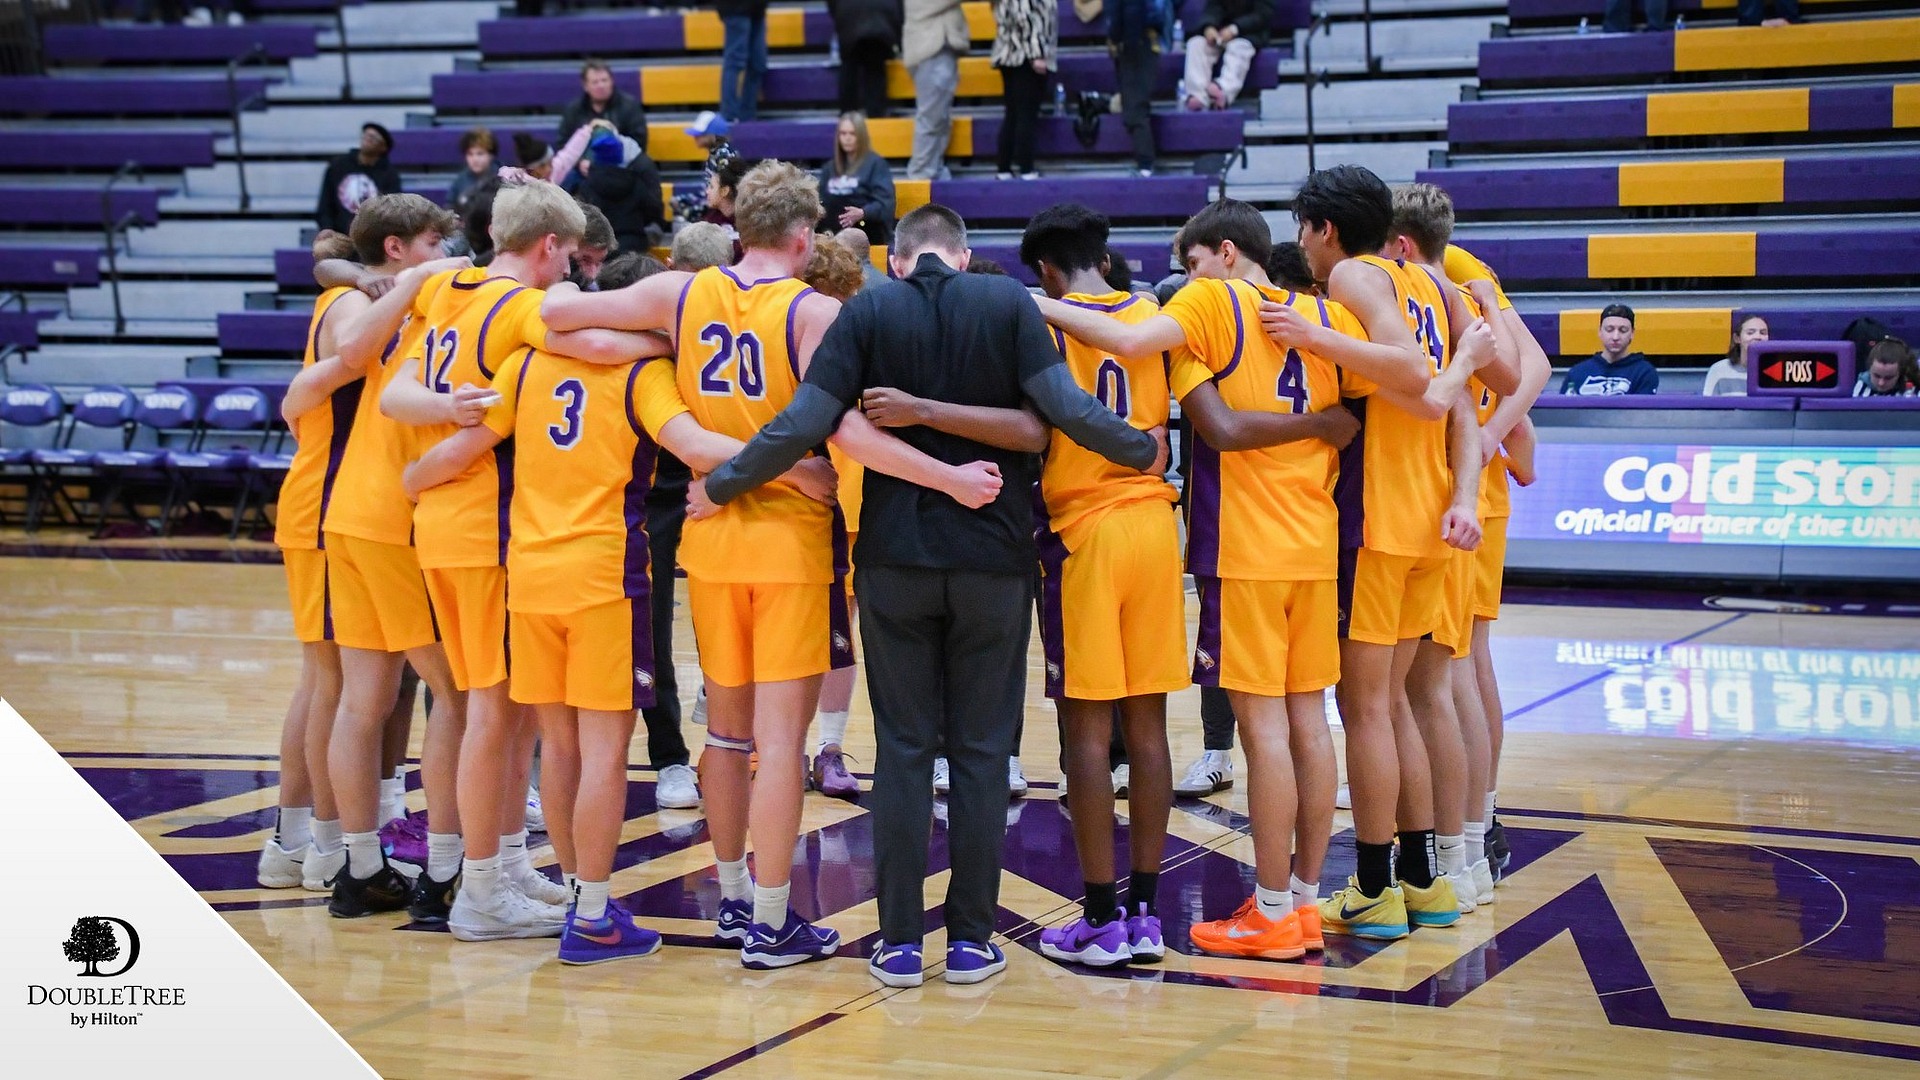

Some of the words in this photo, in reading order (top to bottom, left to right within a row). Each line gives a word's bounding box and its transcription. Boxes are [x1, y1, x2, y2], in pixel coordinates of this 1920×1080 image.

[424, 326, 459, 394] 12
[699, 321, 767, 401] 20
[1095, 357, 1133, 421] 0
[1275, 346, 1310, 414] 4
[1785, 360, 1813, 383] POSS
[548, 377, 588, 451] 3
[1603, 452, 1757, 504] Cold
[1555, 508, 1652, 535] Official
[1653, 512, 1760, 536] Partner
[1762, 512, 1796, 540] of
[1799, 513, 1846, 537] the
